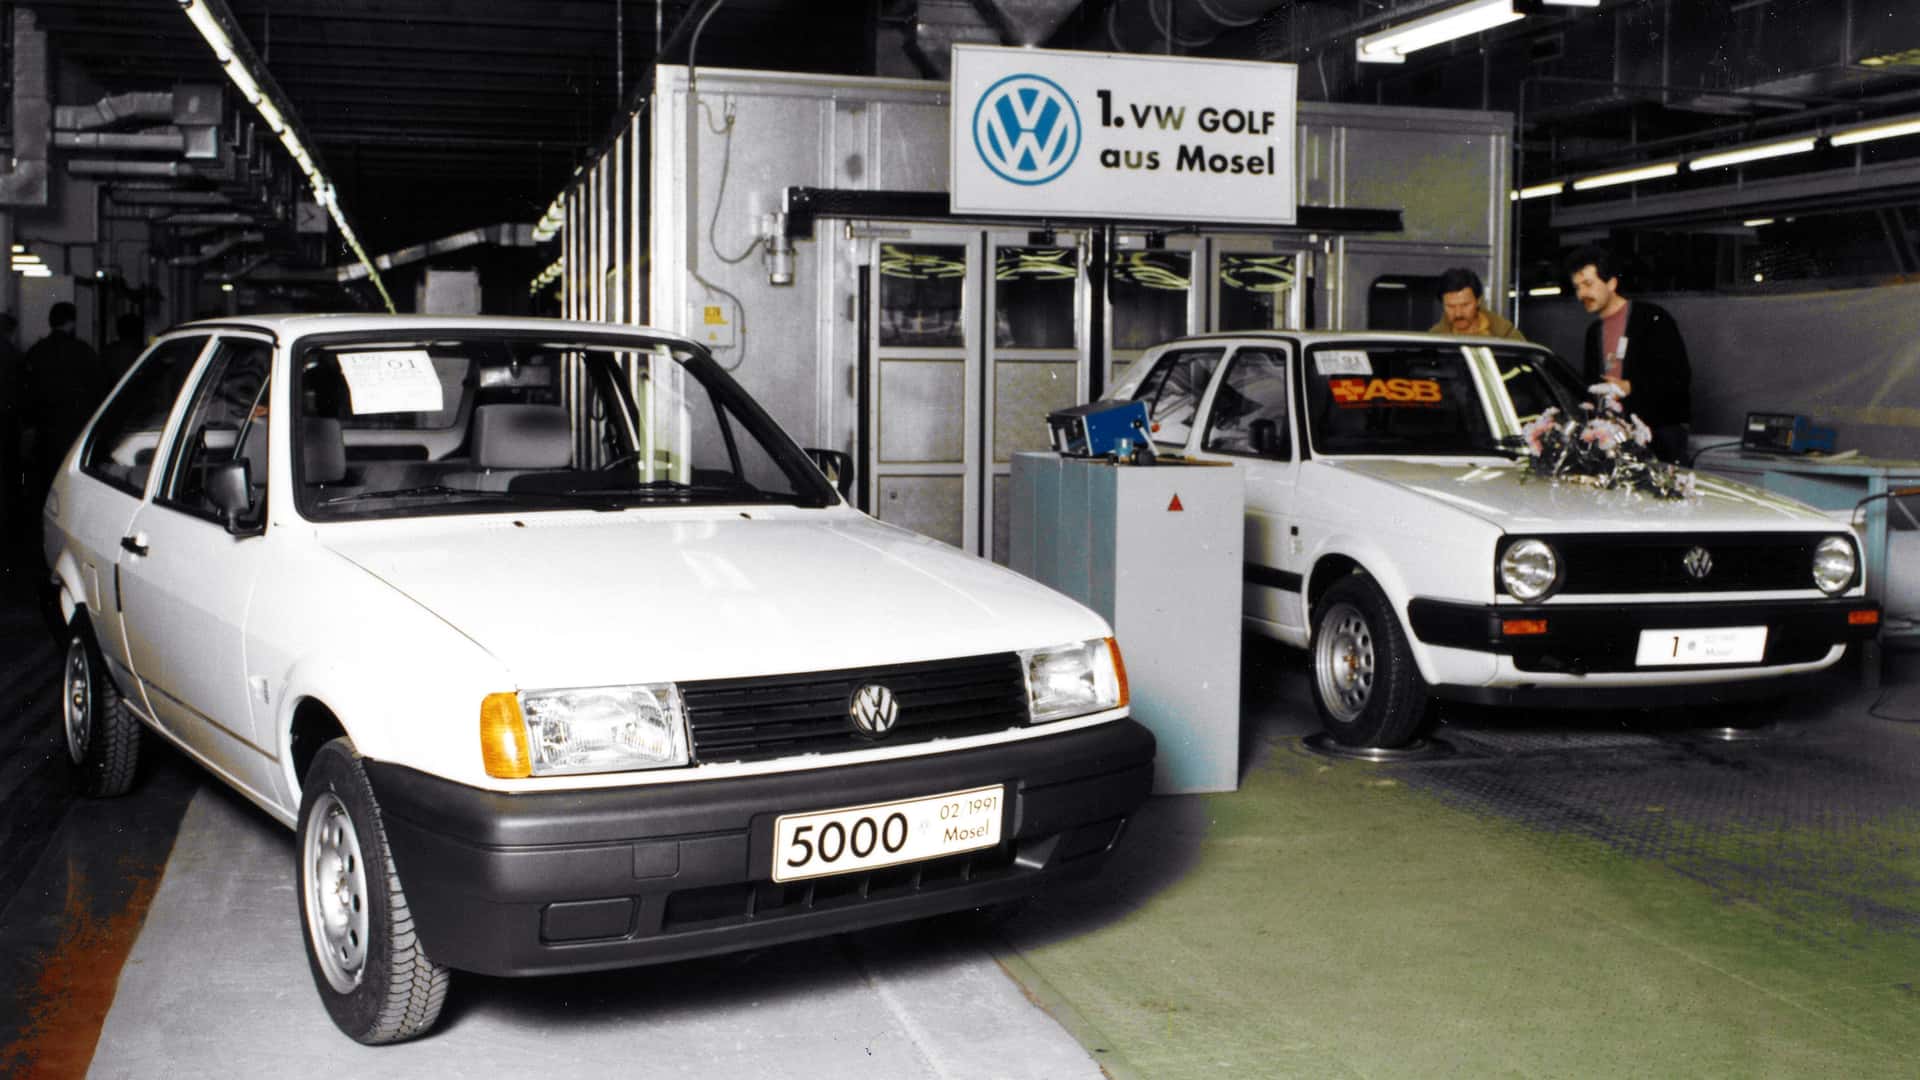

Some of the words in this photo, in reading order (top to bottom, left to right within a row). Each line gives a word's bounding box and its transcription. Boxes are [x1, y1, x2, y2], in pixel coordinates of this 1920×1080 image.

[1198, 107, 1275, 135] GOLF
[1100, 148, 1160, 170] aus
[1176, 144, 1275, 175] Mosel
[1362, 378, 1443, 402] ASB
[1672, 636, 1680, 658] 1
[786, 811, 909, 868] 5000
[943, 818, 990, 844] Mosel
